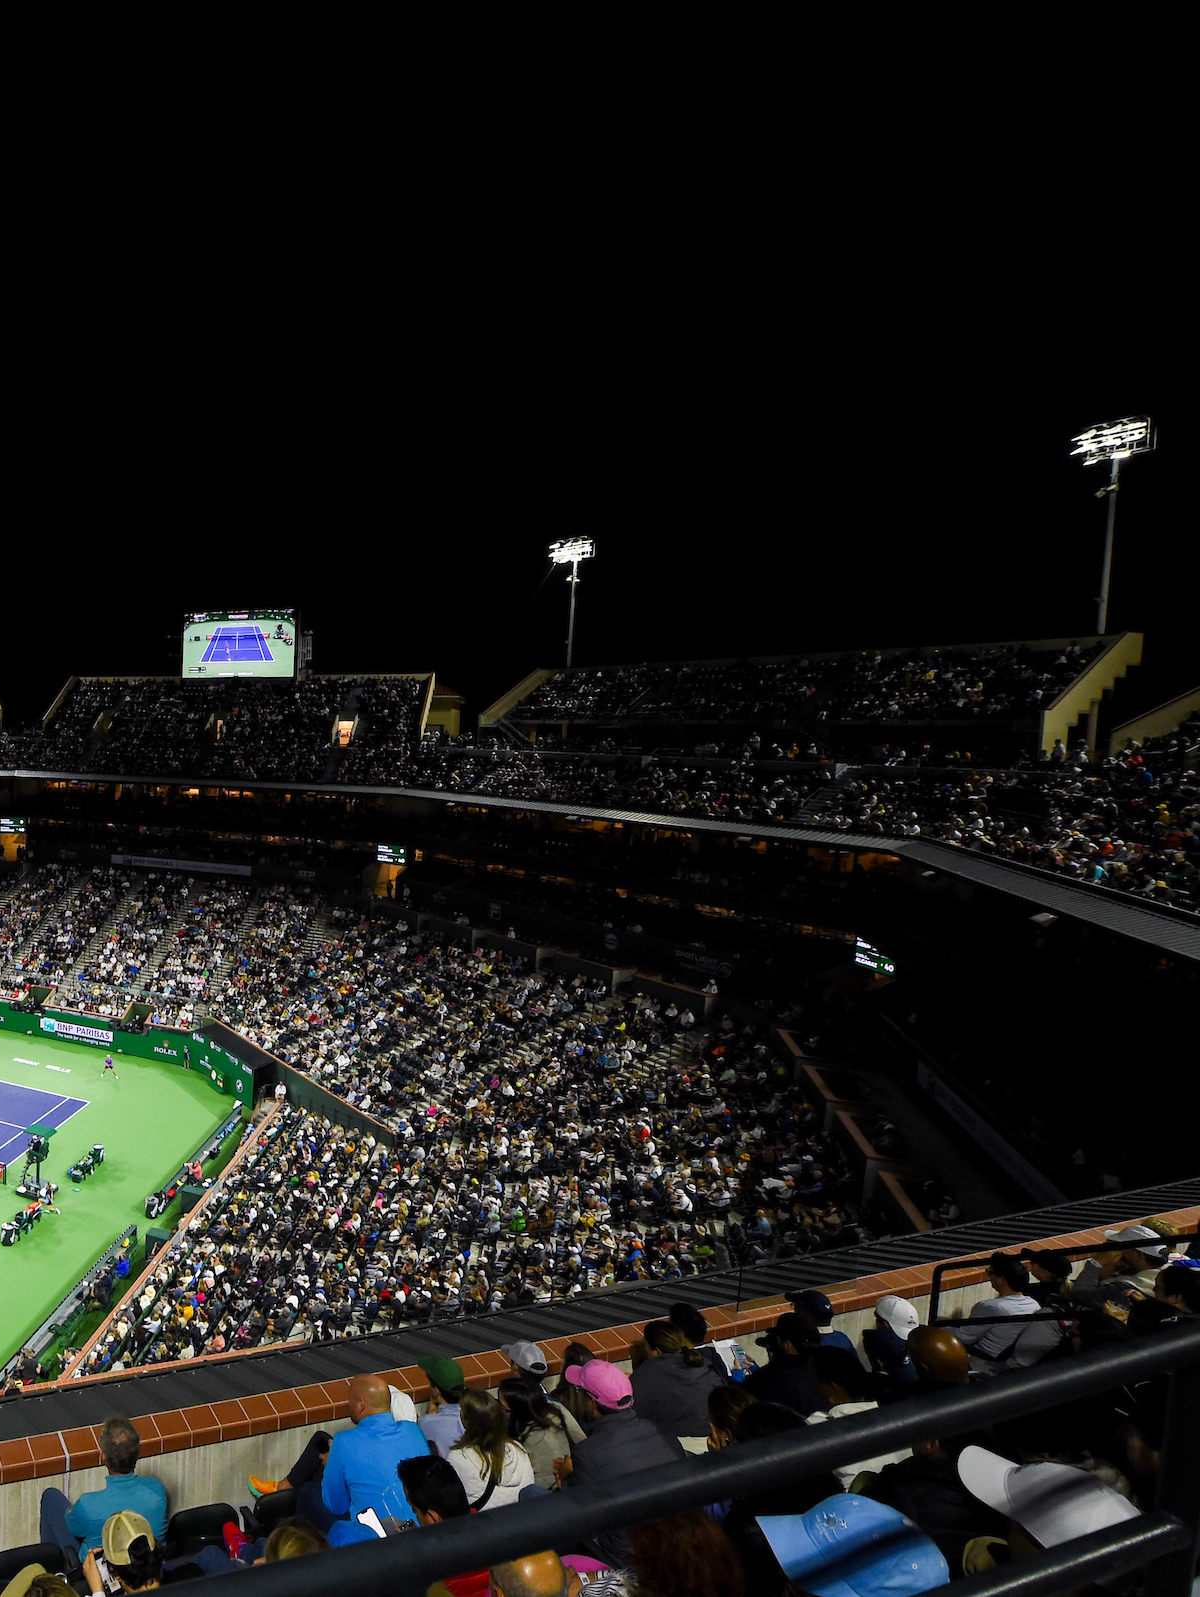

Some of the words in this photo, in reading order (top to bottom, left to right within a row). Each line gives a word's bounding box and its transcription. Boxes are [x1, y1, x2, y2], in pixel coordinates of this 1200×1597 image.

[675, 950, 718, 965] SPOTLIGHT
[883, 963, 895, 973] 40
[57, 1023, 73, 1032] BNP
[76, 1027, 110, 1040] PARIBAS
[154, 1046, 177, 1056] ROLEX
